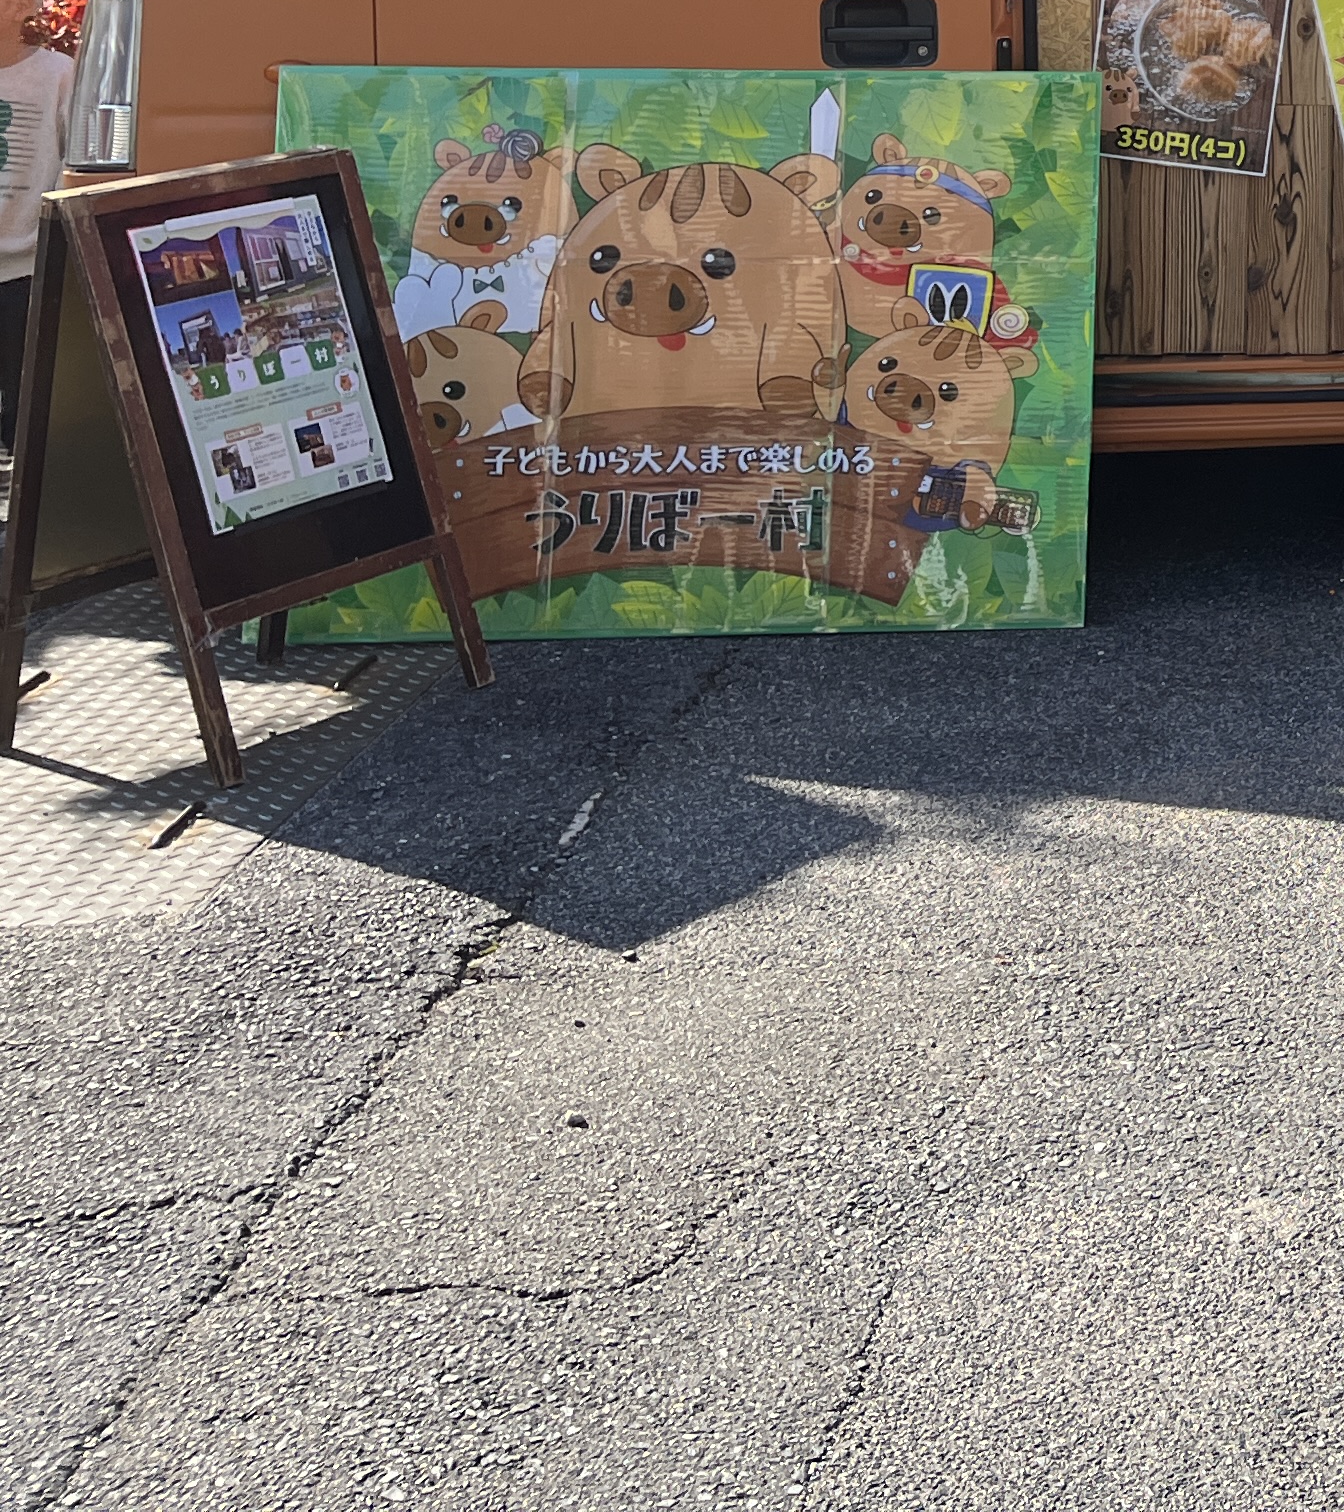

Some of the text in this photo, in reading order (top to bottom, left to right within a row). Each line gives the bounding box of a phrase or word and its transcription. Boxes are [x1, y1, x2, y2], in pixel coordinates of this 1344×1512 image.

[1117, 126, 1246, 166] 350円(4コ)
[484, 445, 876, 477] 子どもから大人まで楽しめる
[525, 487, 827, 556] うりぼー村
